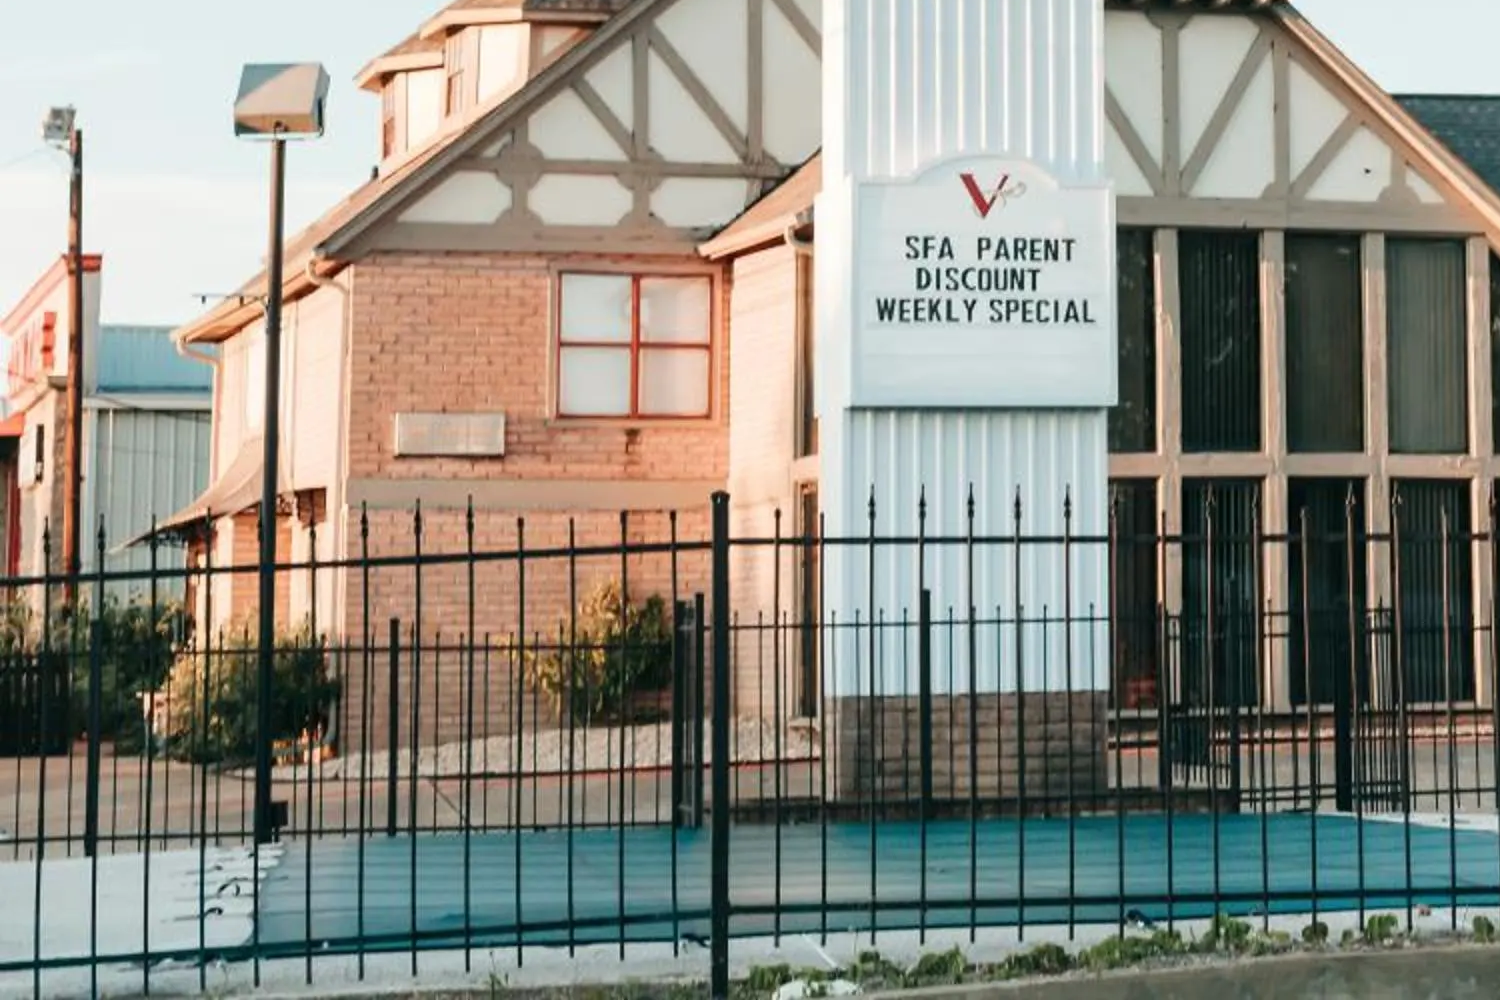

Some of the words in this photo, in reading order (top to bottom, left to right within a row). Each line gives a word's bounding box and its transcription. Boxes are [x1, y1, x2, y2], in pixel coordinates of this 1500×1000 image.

[959, 173, 1008, 218] V
[905, 236, 954, 260] SFA
[977, 238, 1076, 262] PARENT
[916, 268, 1041, 291] DISCOUNT
[876, 298, 977, 322] WEEKLY
[989, 300, 1096, 323] SPECIAL
